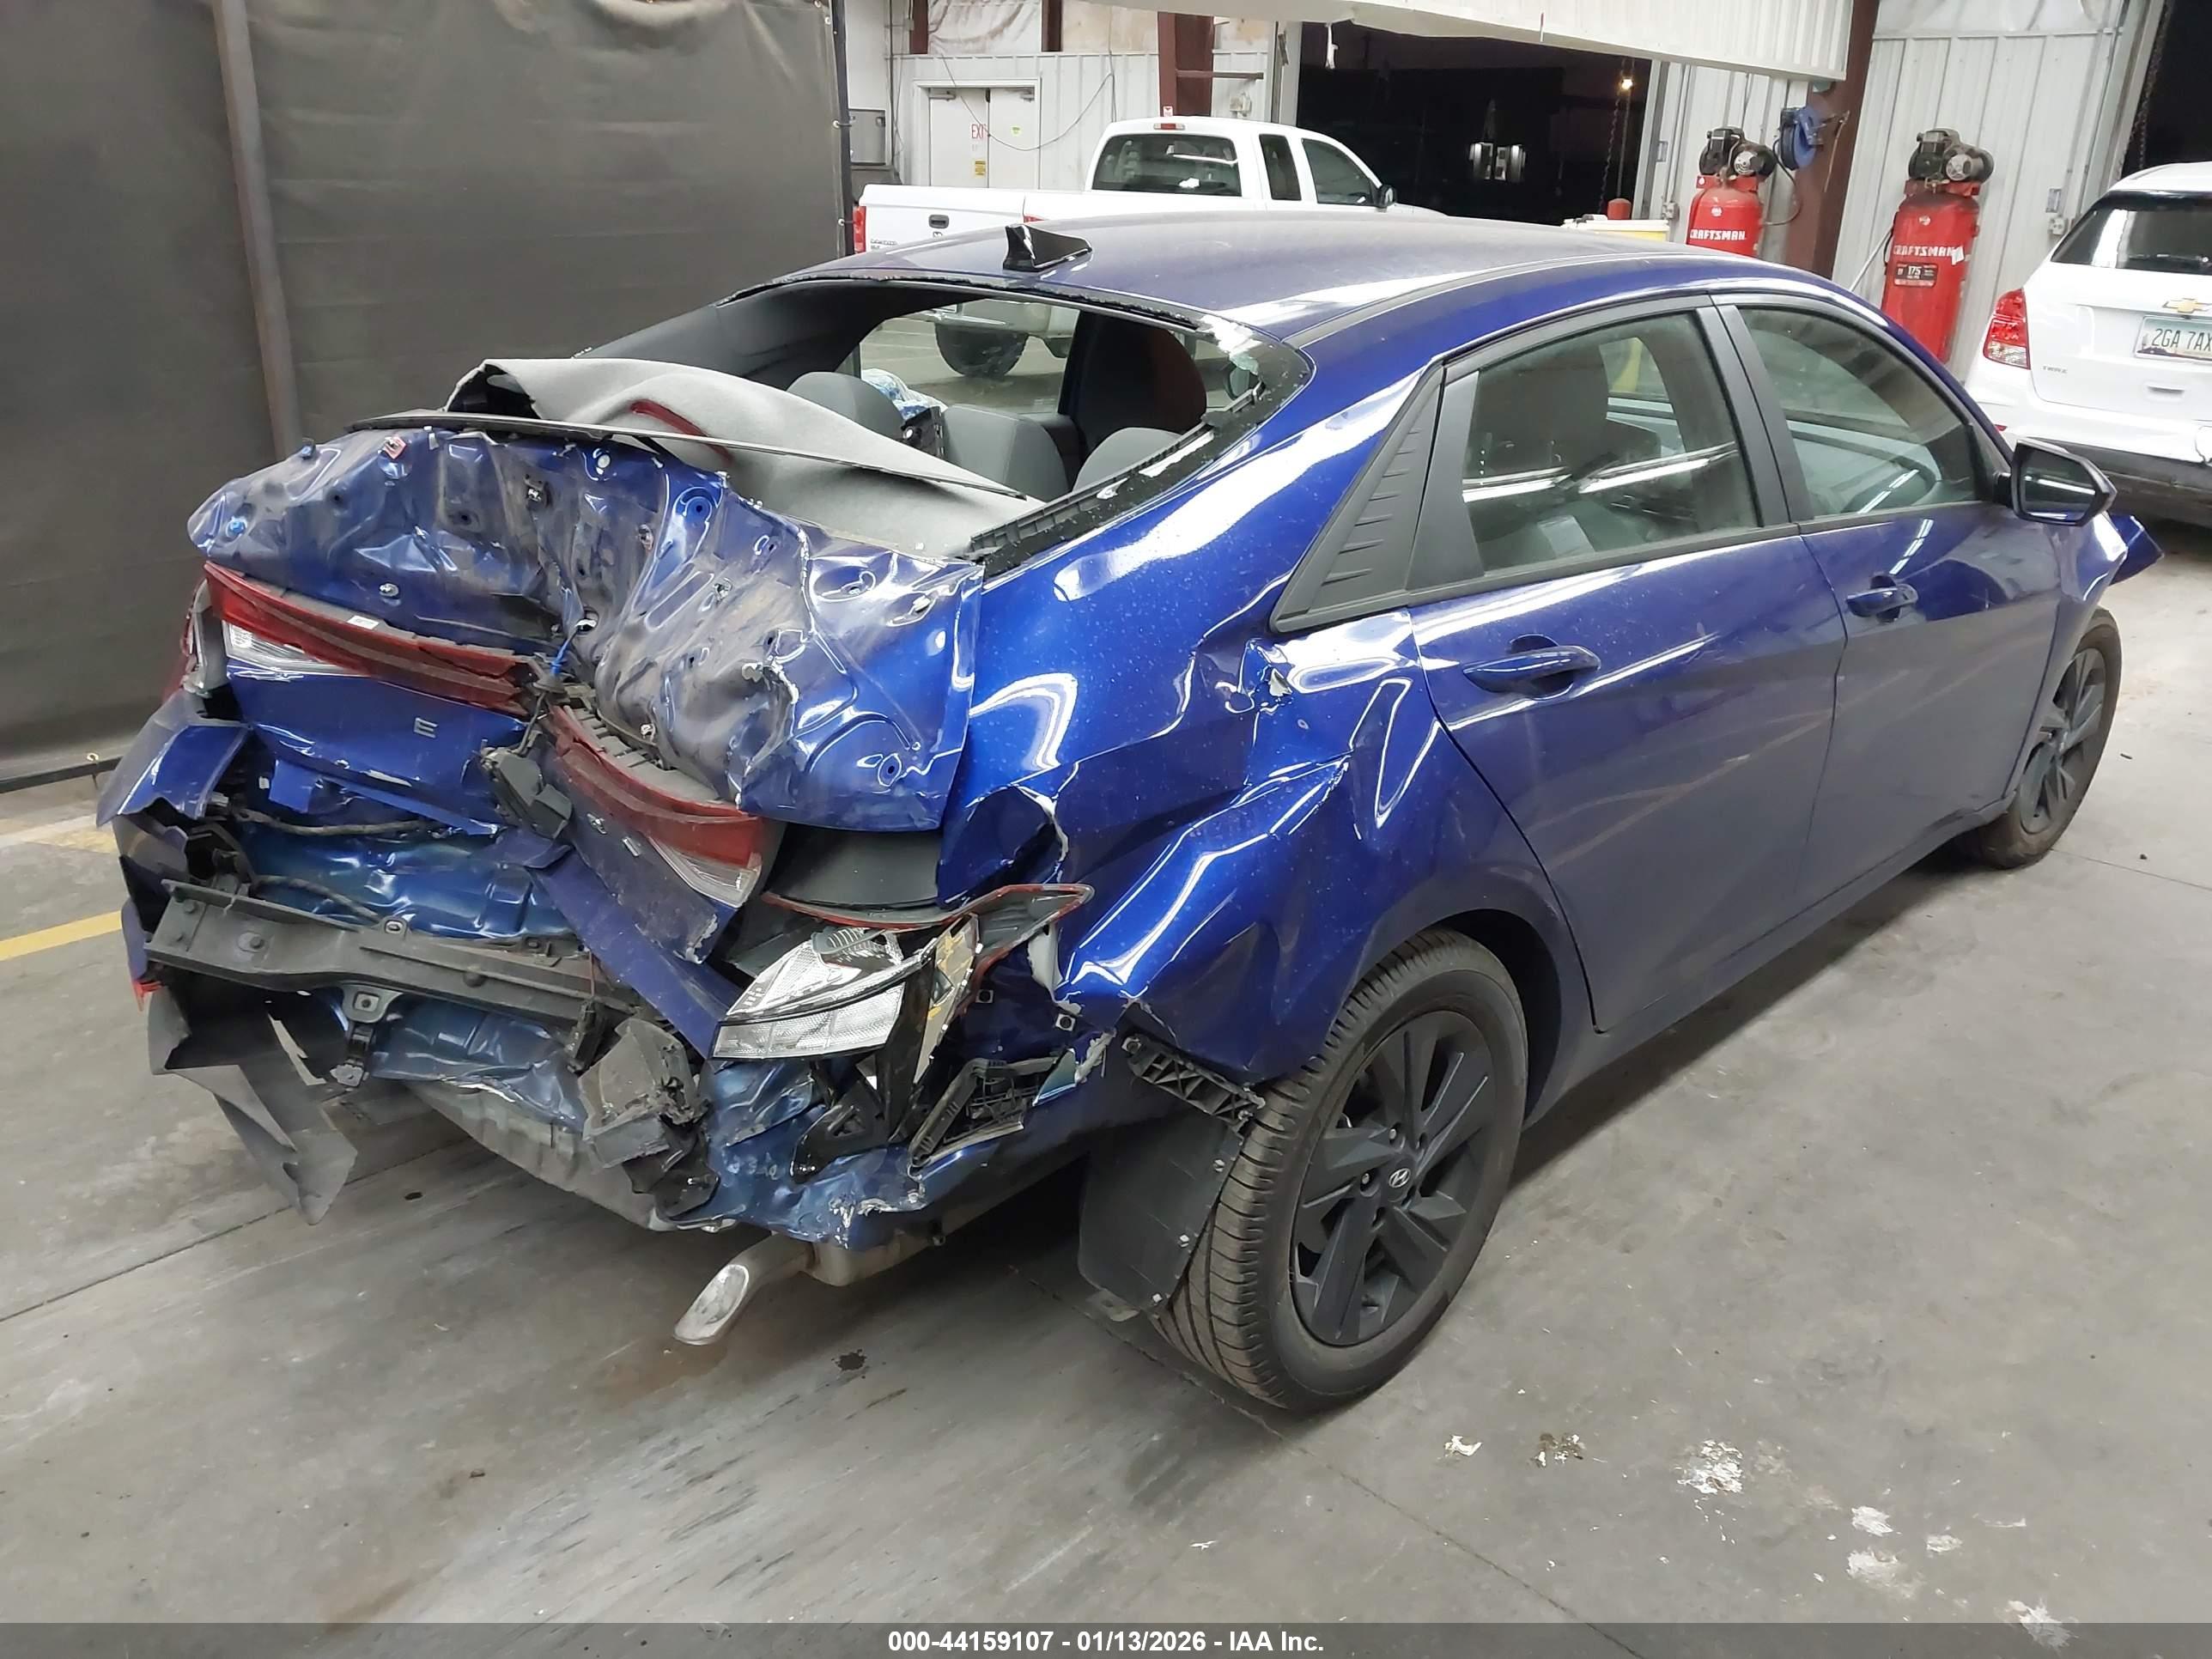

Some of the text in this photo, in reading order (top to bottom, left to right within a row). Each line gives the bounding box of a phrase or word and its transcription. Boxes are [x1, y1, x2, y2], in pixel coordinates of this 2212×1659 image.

[1690, 229, 1745, 240] CRAFTSMAN
[1908, 265, 1922, 276] 175
[2152, 328, 2212, 351] 2GA 7AX
